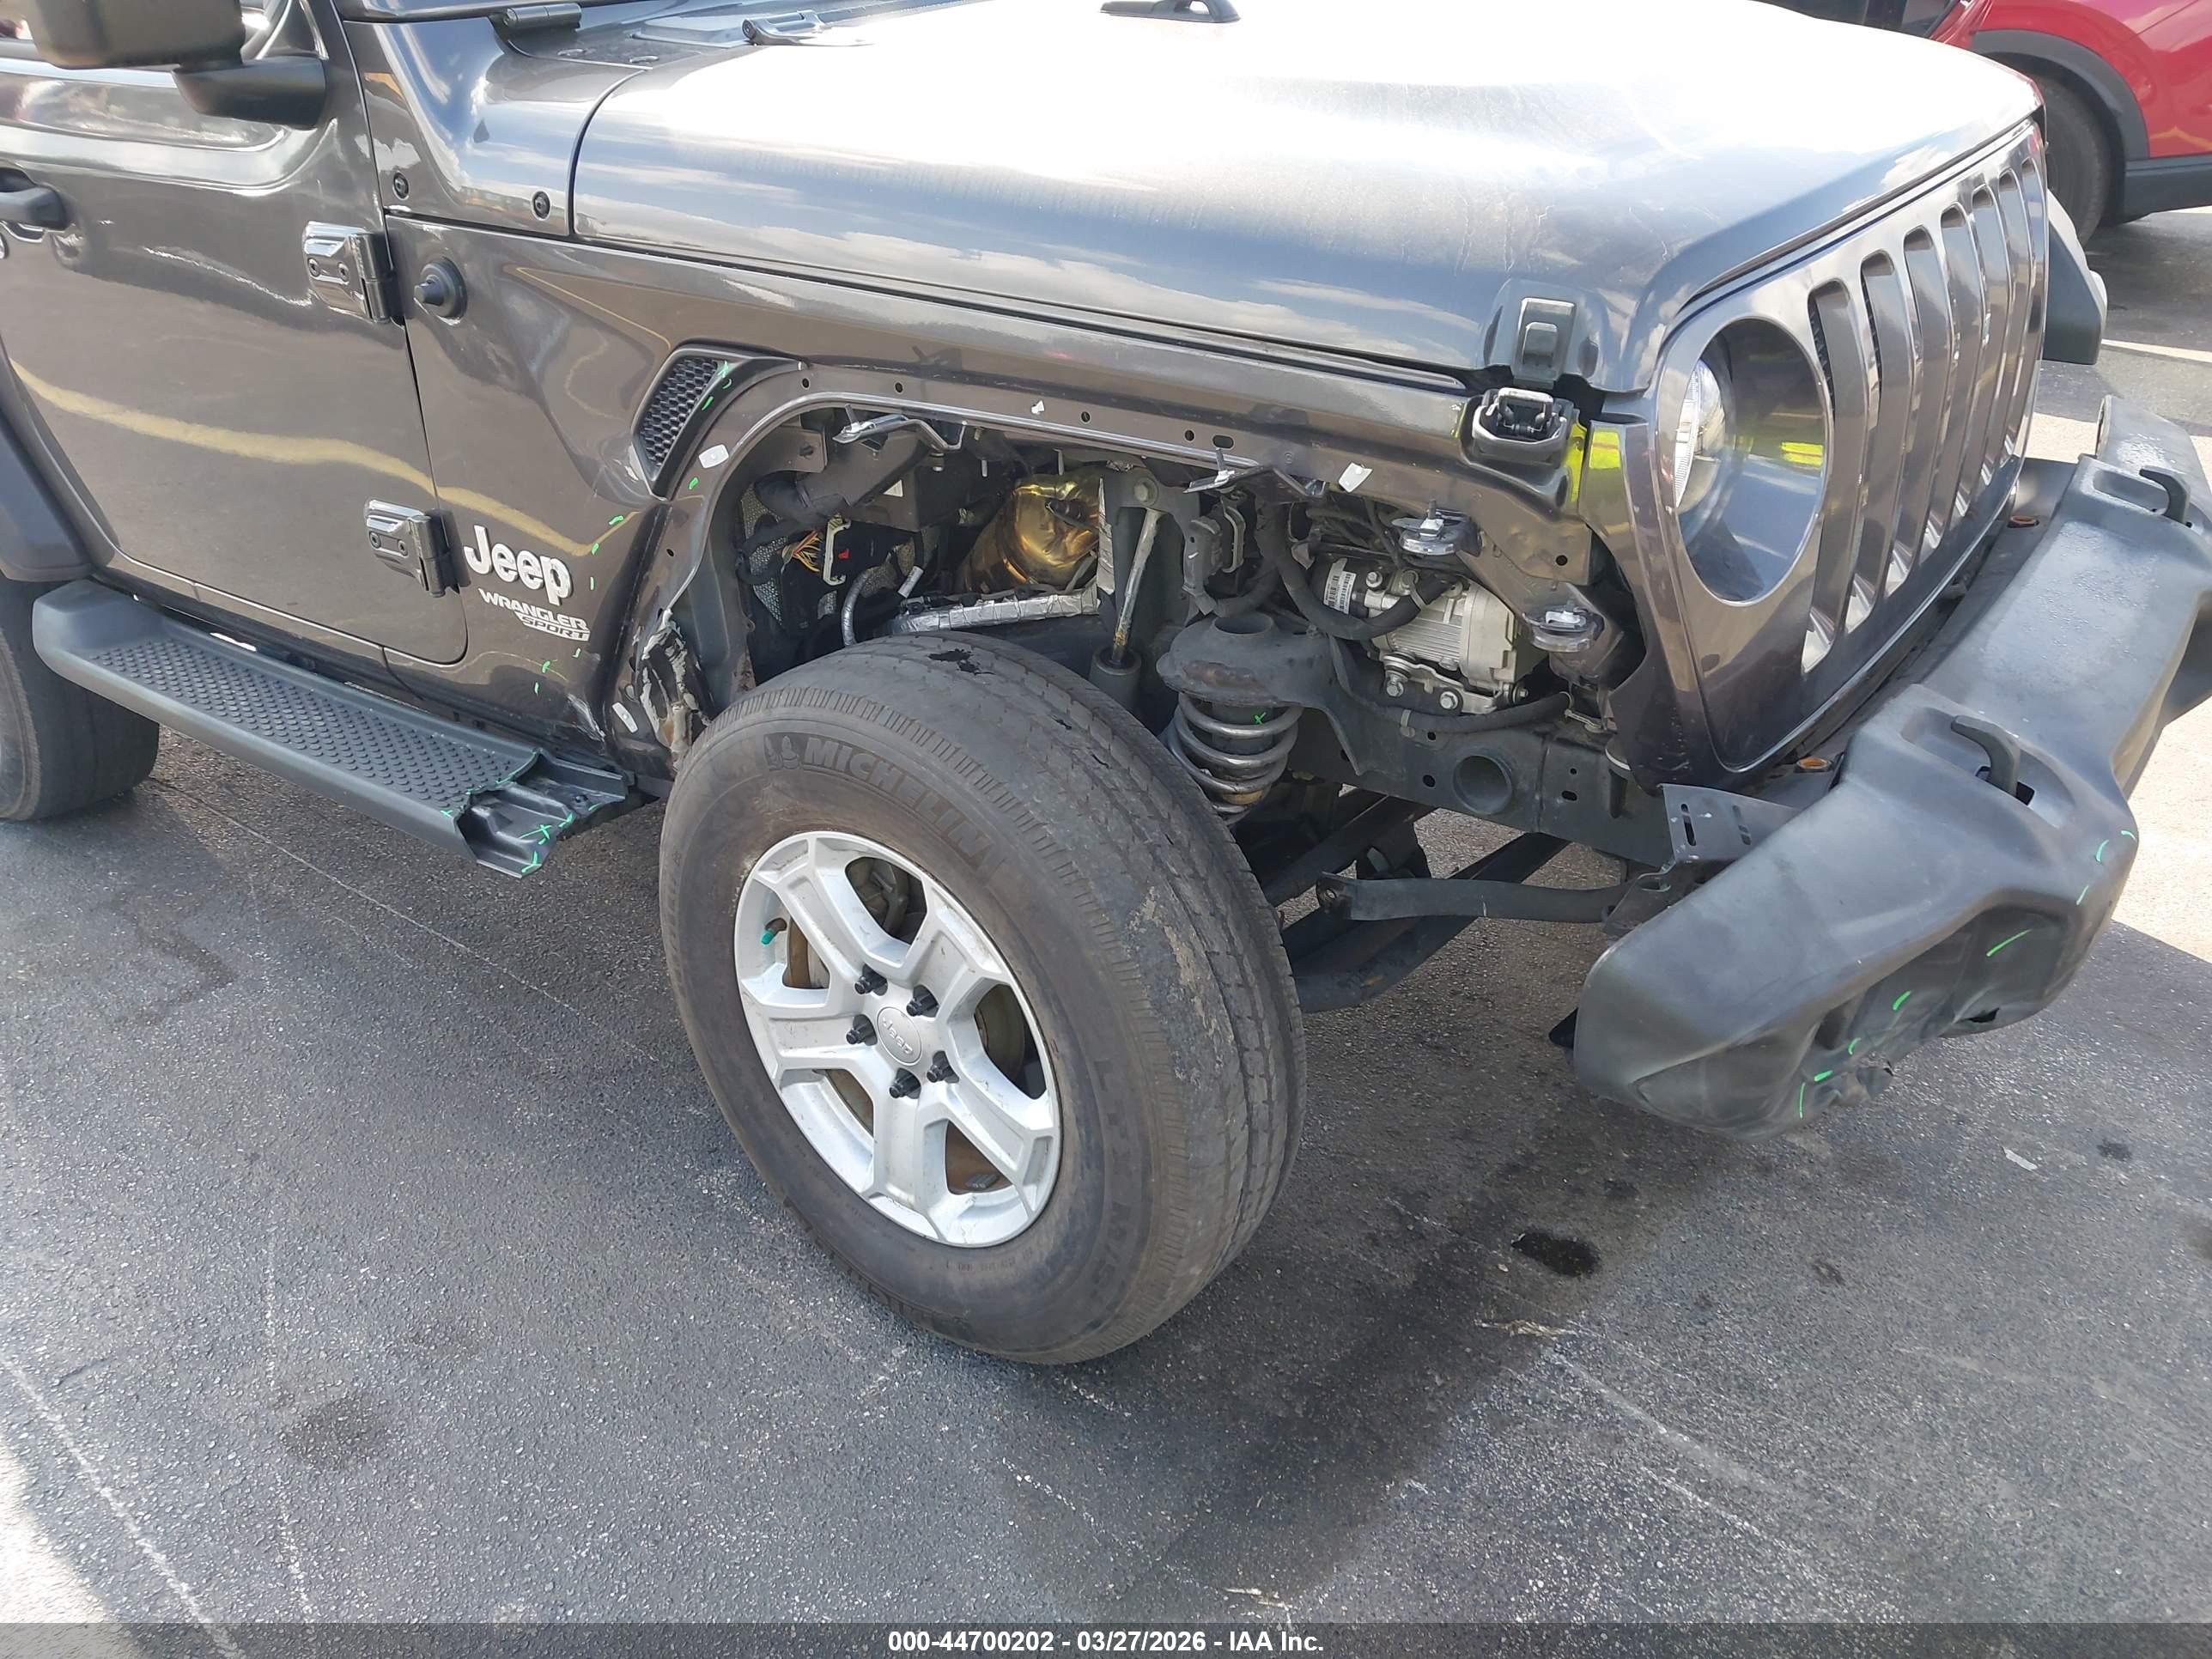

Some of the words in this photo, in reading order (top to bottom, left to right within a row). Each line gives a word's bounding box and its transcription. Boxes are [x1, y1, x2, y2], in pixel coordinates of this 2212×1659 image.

[464, 525, 574, 606] Jeep
[477, 587, 590, 630] WRANGLER
[520, 615, 590, 641] SPORT
[803, 736, 993, 867] MICHELIN
